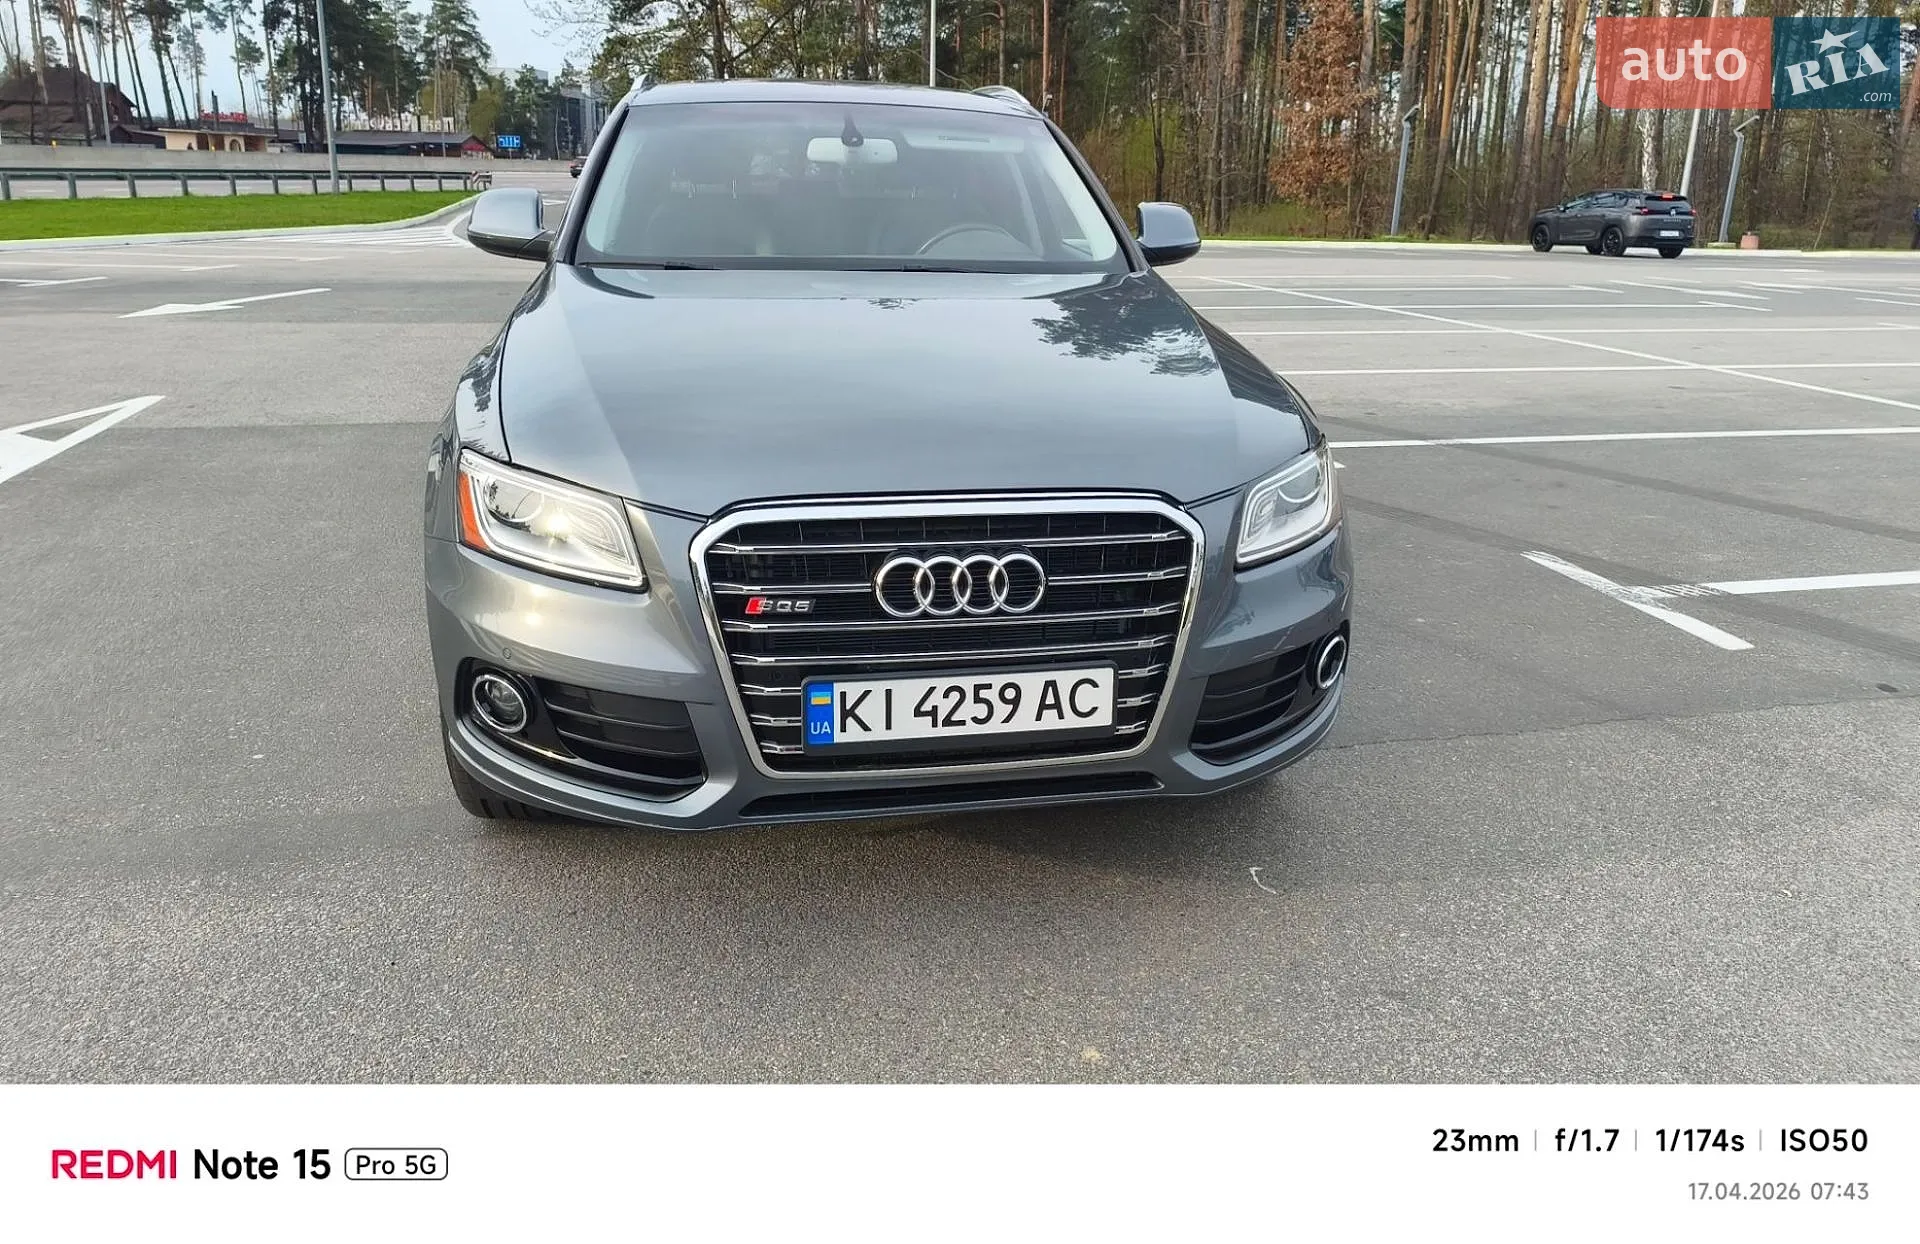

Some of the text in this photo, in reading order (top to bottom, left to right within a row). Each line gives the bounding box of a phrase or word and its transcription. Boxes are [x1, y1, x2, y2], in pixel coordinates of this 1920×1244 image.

[758, 599, 811, 613] SQ5
[839, 677, 1101, 733] KI 4259 AC
[810, 721, 832, 735] UA
